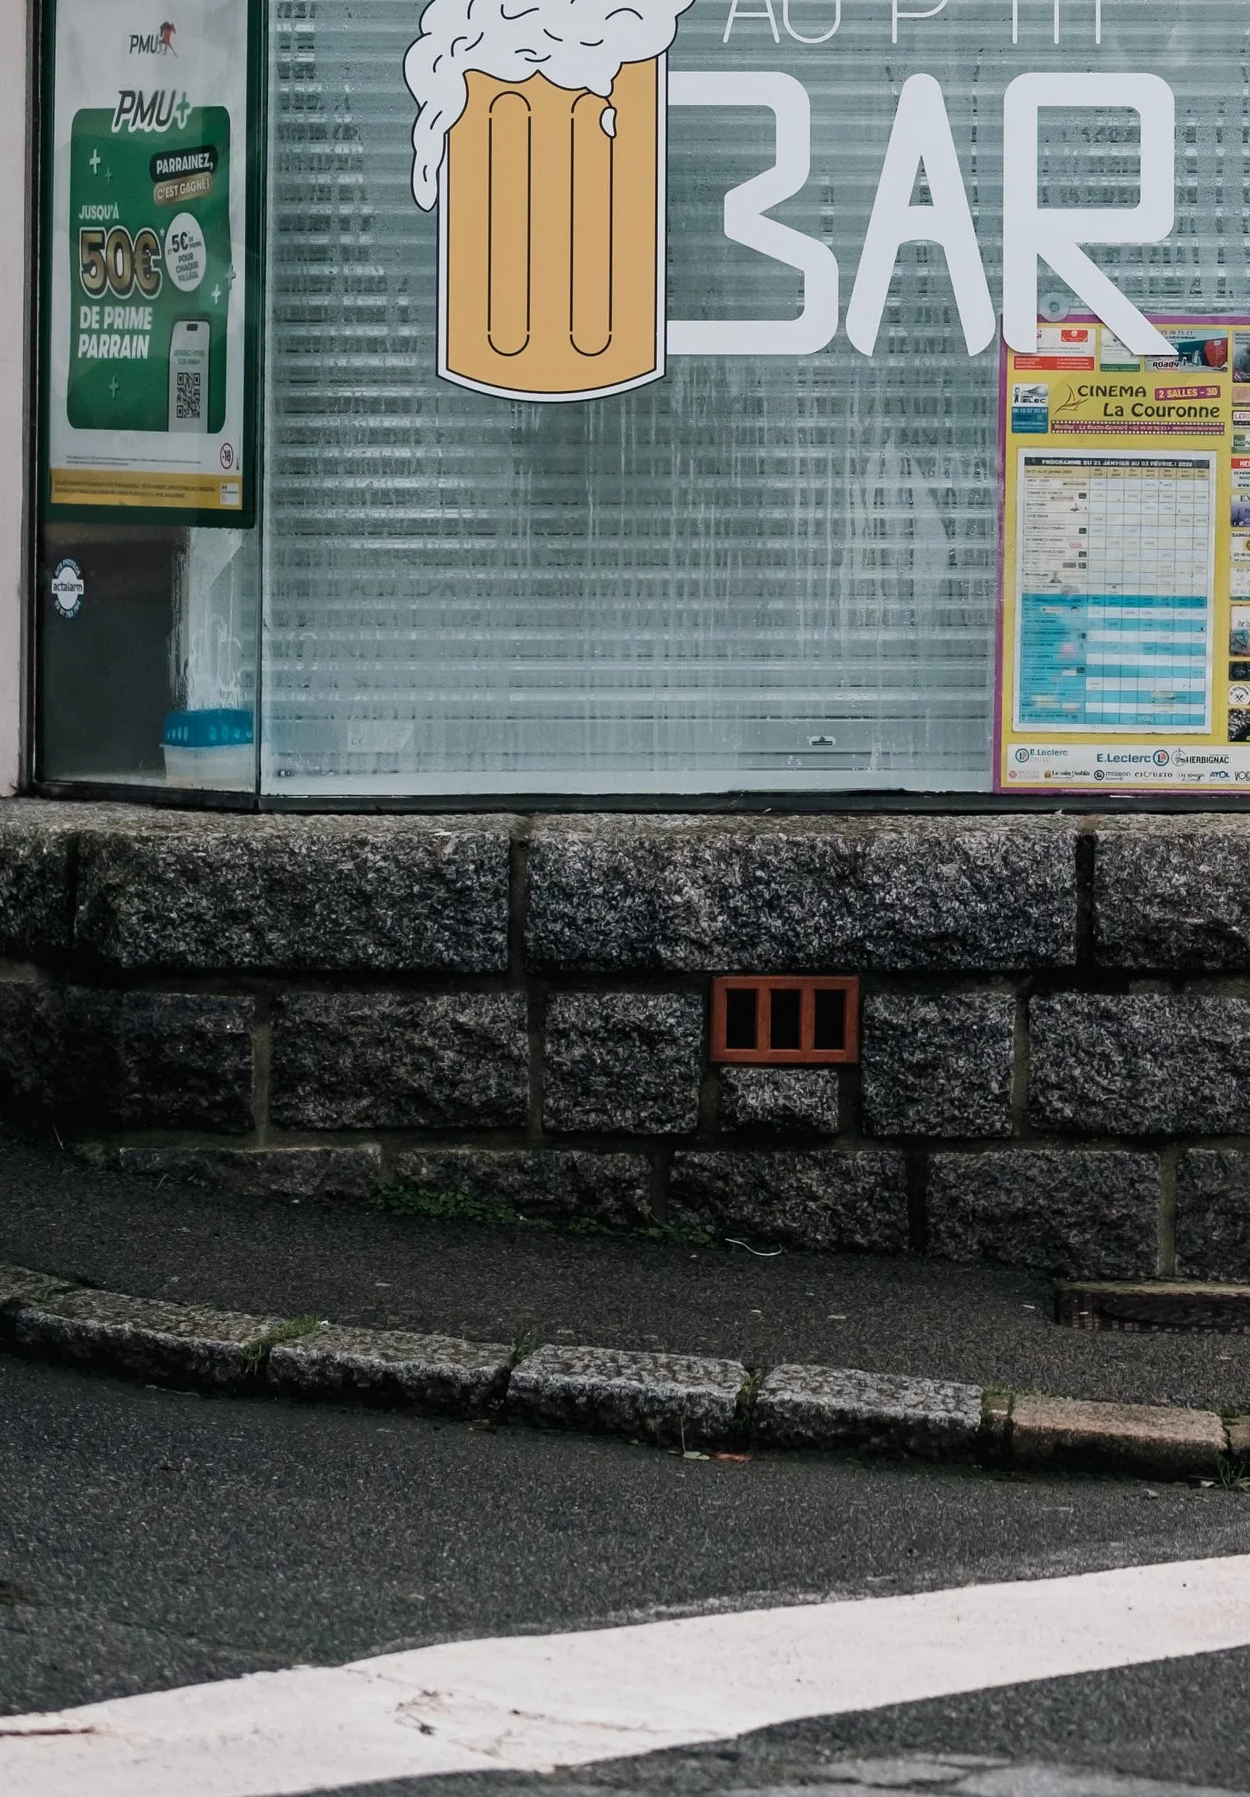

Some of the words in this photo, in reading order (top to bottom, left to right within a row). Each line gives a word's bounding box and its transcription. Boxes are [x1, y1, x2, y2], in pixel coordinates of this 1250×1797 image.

[129, 34, 158, 54] PMU
[156, 152, 214, 175] PARRAINEZ,
[667, 70, 1180, 357] BAR
[80, 306, 99, 330] DE
[103, 306, 153, 331] PRIME
[78, 333, 150, 359] PARRAIN
[1077, 385, 1147, 397] CINEMA
[1158, 390, 1165, 398] 2
[1166, 388, 1198, 398] SALLES
[1206, 388, 1218, 396] 3D
[1103, 403, 1125, 418] La
[1131, 403, 1221, 418] Couronne
[1097, 753, 1151, 763] E.Leclerc
[1186, 756, 1230, 764] HERBIGNAC
